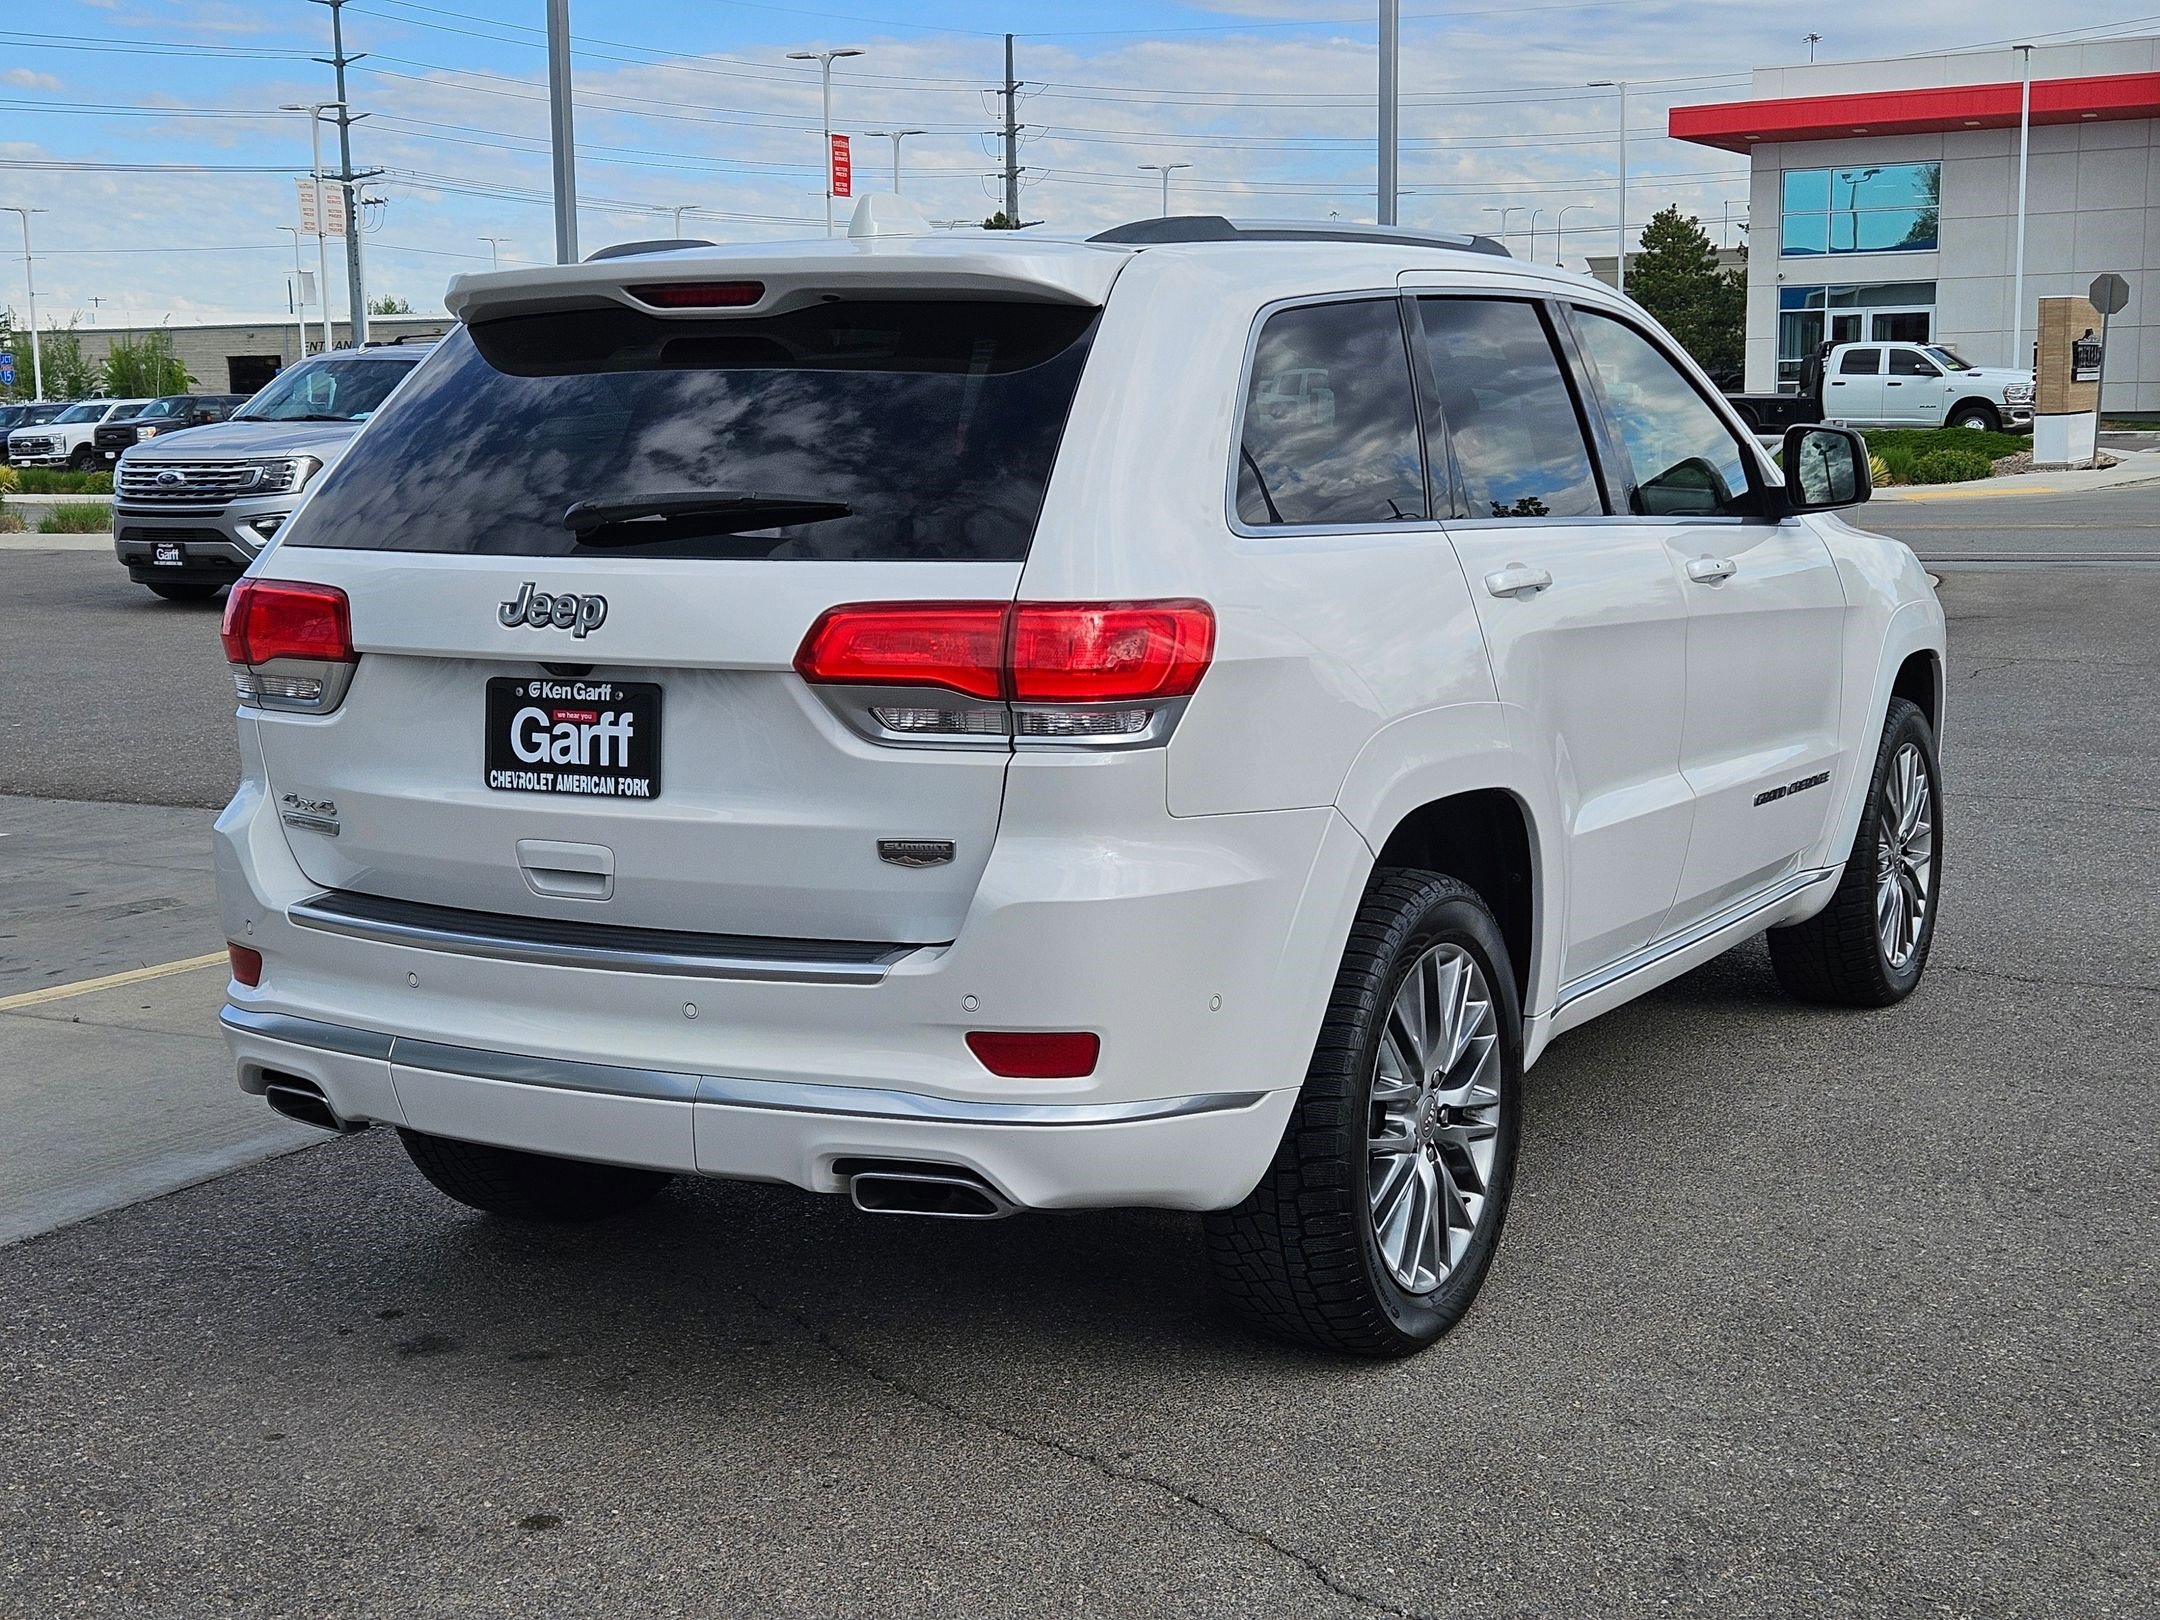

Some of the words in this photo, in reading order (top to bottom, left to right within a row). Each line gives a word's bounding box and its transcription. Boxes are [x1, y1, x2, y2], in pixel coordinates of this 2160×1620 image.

[1, 355, 11, 364] JCT
[3, 370, 12, 382] 15
[499, 581, 608, 639] Jeep
[542, 681, 572, 700] Ken
[573, 682, 612, 701] Garff
[556, 711, 566, 719] we
[566, 711, 580, 719] hear
[580, 713, 593, 721] you
[510, 706, 634, 768] Garff
[489, 769, 554, 791] CHEVROLET
[556, 776, 615, 795] AMERICAN
[617, 777, 650, 797] FORK
[1786, 770, 1831, 797] CHEROKEE
